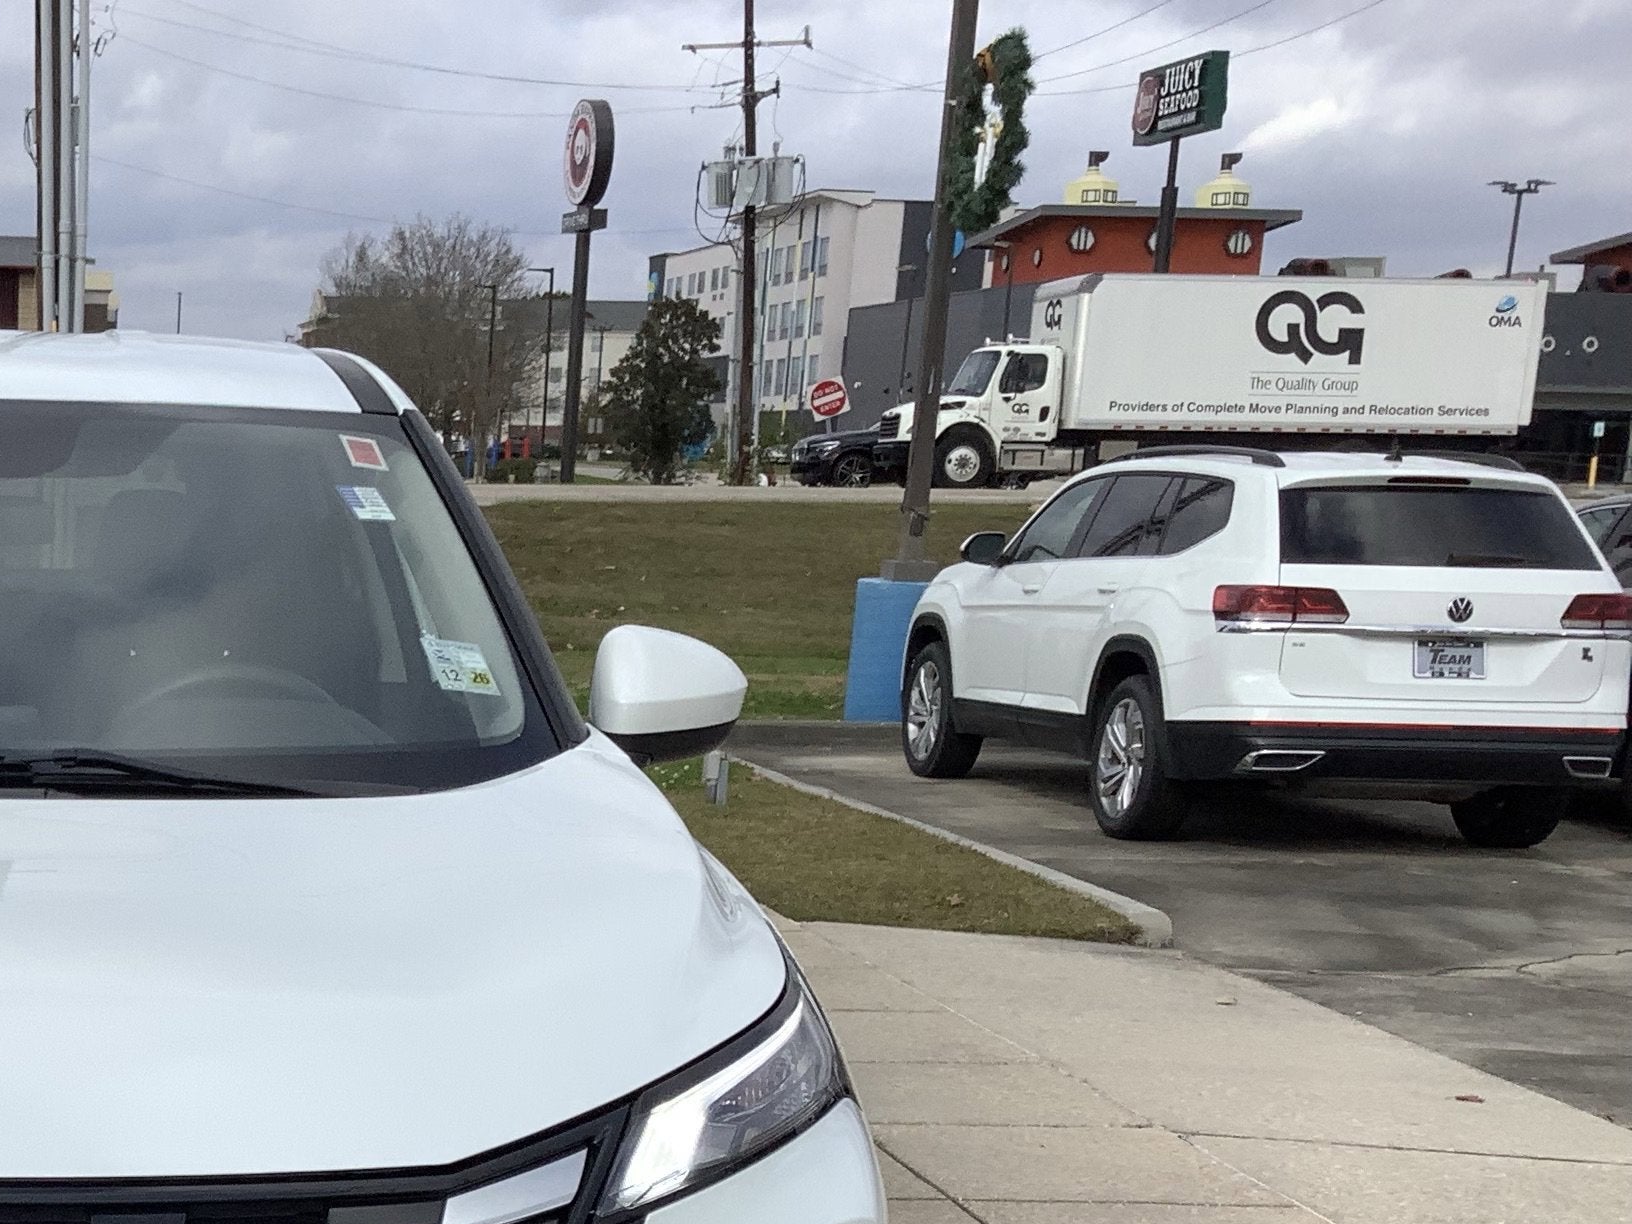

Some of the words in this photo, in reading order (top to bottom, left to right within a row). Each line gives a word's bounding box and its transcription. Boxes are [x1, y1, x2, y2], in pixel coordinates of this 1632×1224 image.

[1160, 59, 1204, 97] JUICY
[1158, 89, 1200, 117] SEAFOOD
[1255, 290, 1365, 365] QG
[1488, 315, 1522, 328] OMA
[813, 390, 824, 399] DO
[825, 384, 839, 394] NOT
[1250, 377, 1272, 391] The
[1275, 377, 1318, 392] Quality
[1321, 378, 1359, 394] Group
[820, 400, 841, 413] ENTER
[1109, 401, 1168, 413] Providers
[1171, 402, 1184, 413] of
[1187, 402, 1245, 415] Complete
[1248, 403, 1282, 414] Move
[1285, 403, 1338, 417] Planning
[1342, 404, 1365, 416] and
[1369, 404, 1434, 416] Relocation
[1437, 405, 1490, 417] Services
[1429, 649, 1472, 665] TEAM
[441, 669, 462, 682] 12
